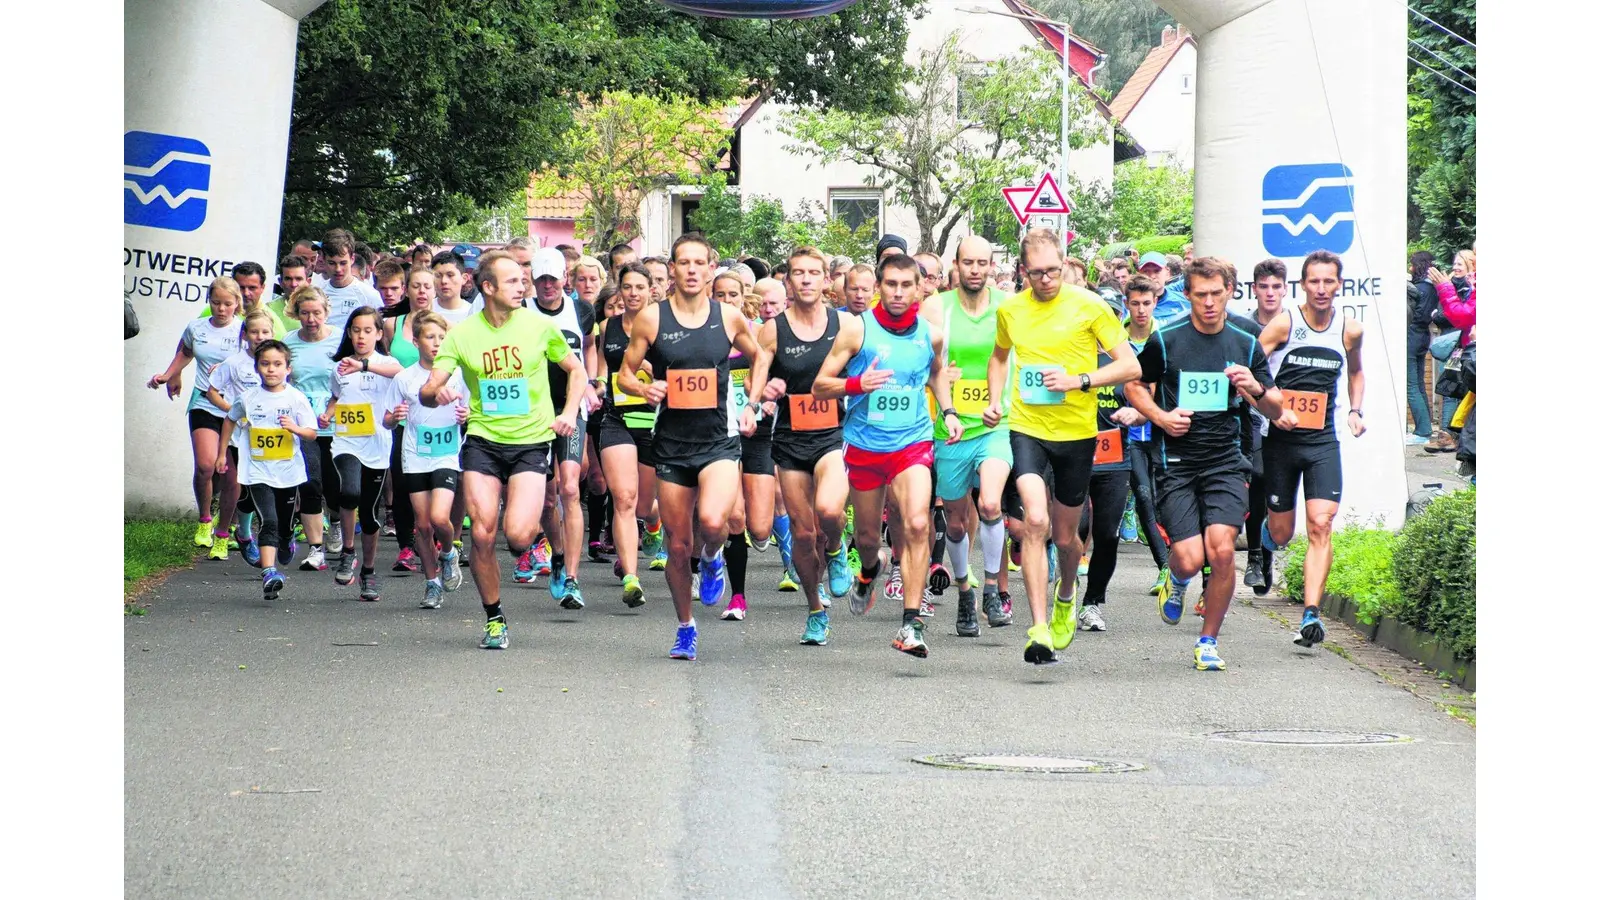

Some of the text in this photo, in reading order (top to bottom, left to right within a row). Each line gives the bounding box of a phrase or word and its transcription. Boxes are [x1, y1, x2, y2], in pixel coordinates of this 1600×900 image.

[482, 345, 523, 375] DETS
[1287, 354, 1342, 369] BLADE RUNNER
[675, 376, 708, 392] 150
[1025, 371, 1044, 387] 89
[1188, 379, 1219, 394] 931
[487, 384, 520, 400] 895
[962, 388, 990, 401] 592
[1096, 386, 1115, 396] AK
[798, 400, 829, 415] 140
[877, 396, 910, 411] 899
[1288, 396, 1319, 413] 135
[340, 411, 366, 424] 565
[257, 435, 284, 448] 567
[423, 431, 452, 445] 910
